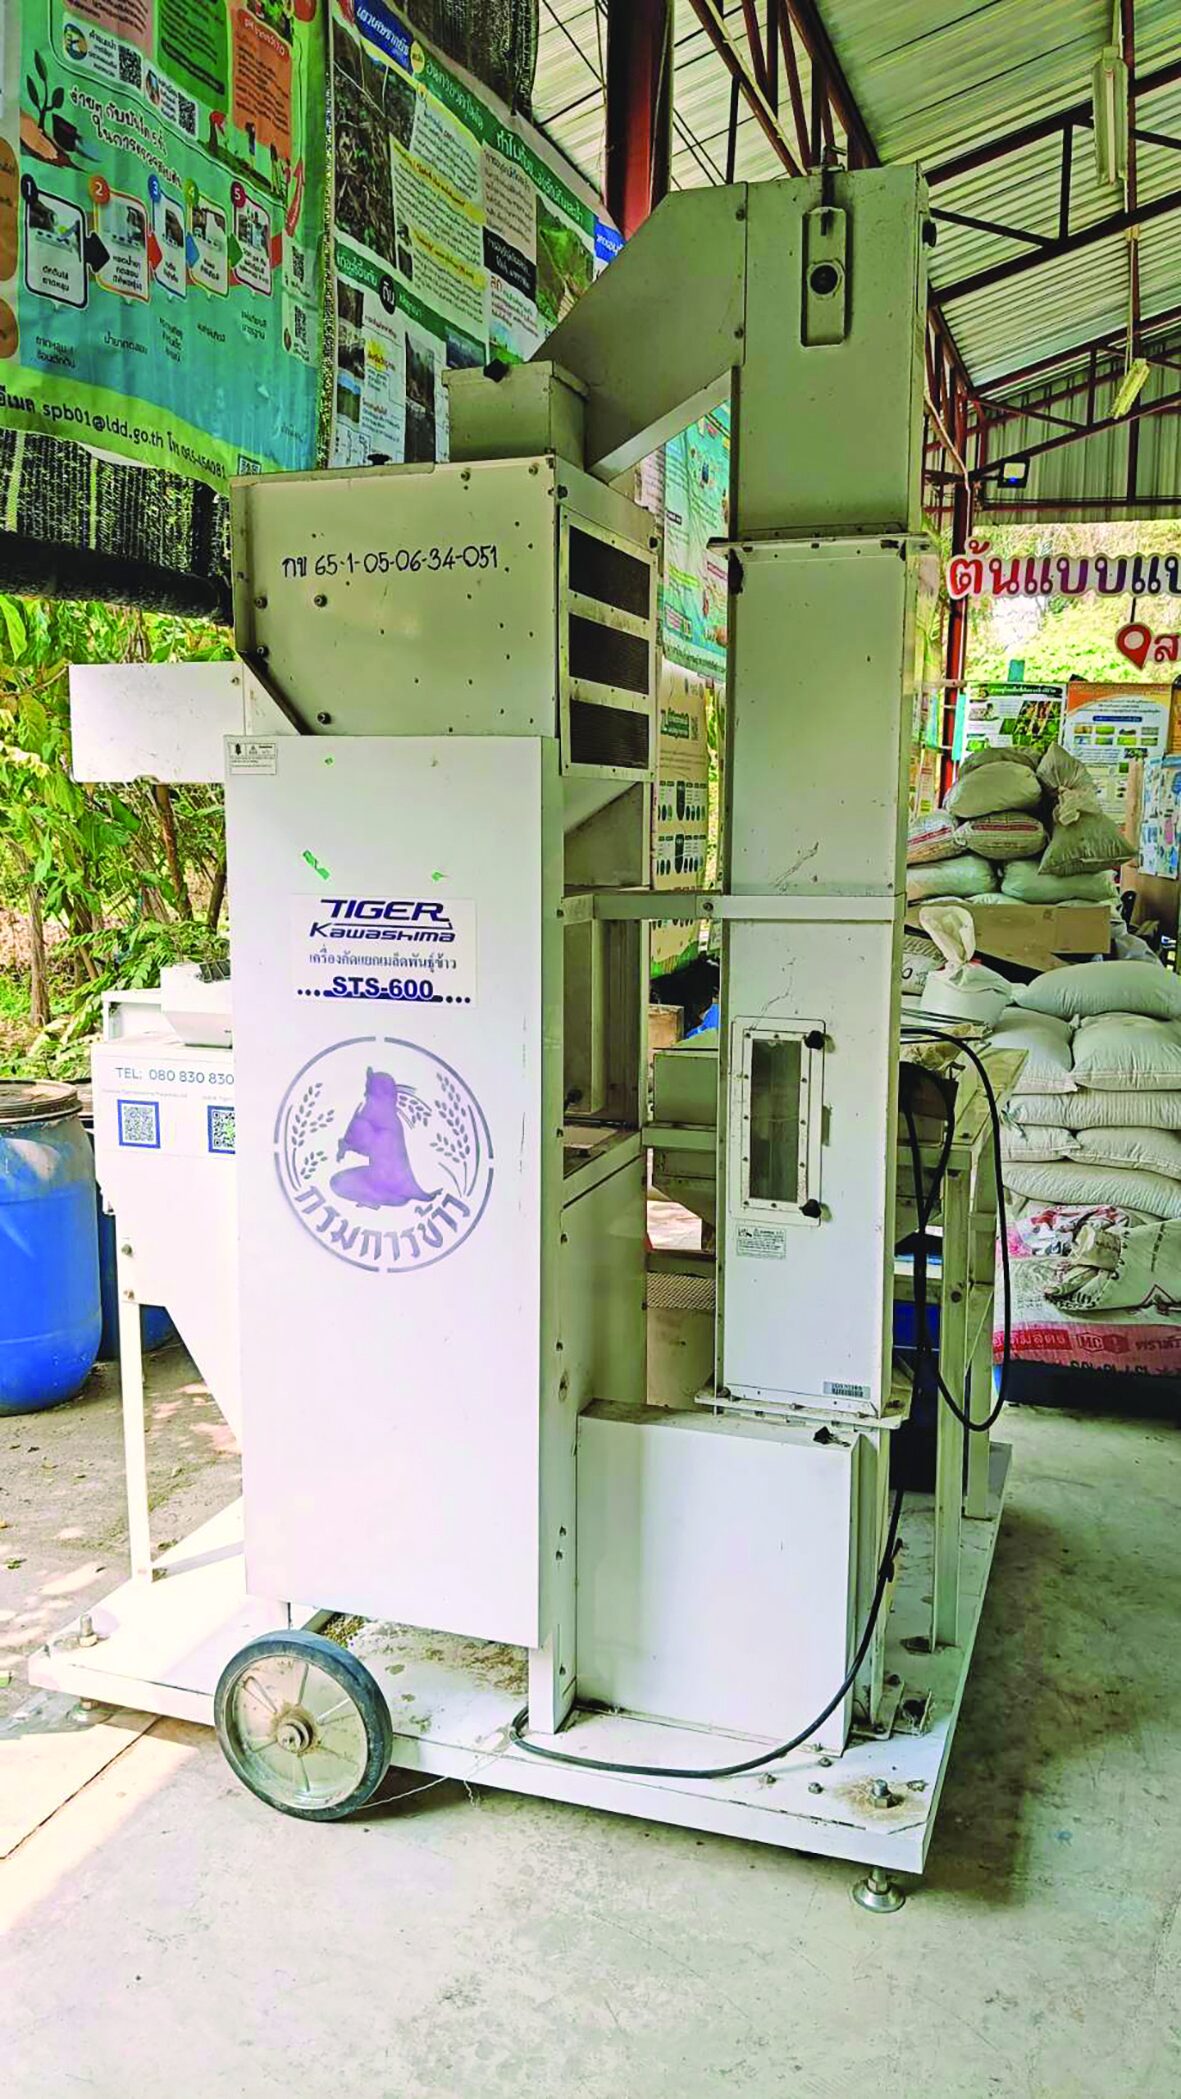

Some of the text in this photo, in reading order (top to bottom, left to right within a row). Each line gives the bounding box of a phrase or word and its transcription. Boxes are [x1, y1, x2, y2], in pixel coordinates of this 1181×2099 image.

[43, 402, 163, 448] spb01@ldd.go.th
[315, 544, 498, 576] 65-1-05-06-34-051
[320, 898, 452, 923] TIGER
[309, 921, 456, 943] Kawashima
[332, 975, 434, 999] STS-600
[115, 1067, 235, 1085] TEL: 080 830 830
[295, 1185, 471, 1261] กรมการข้าว
